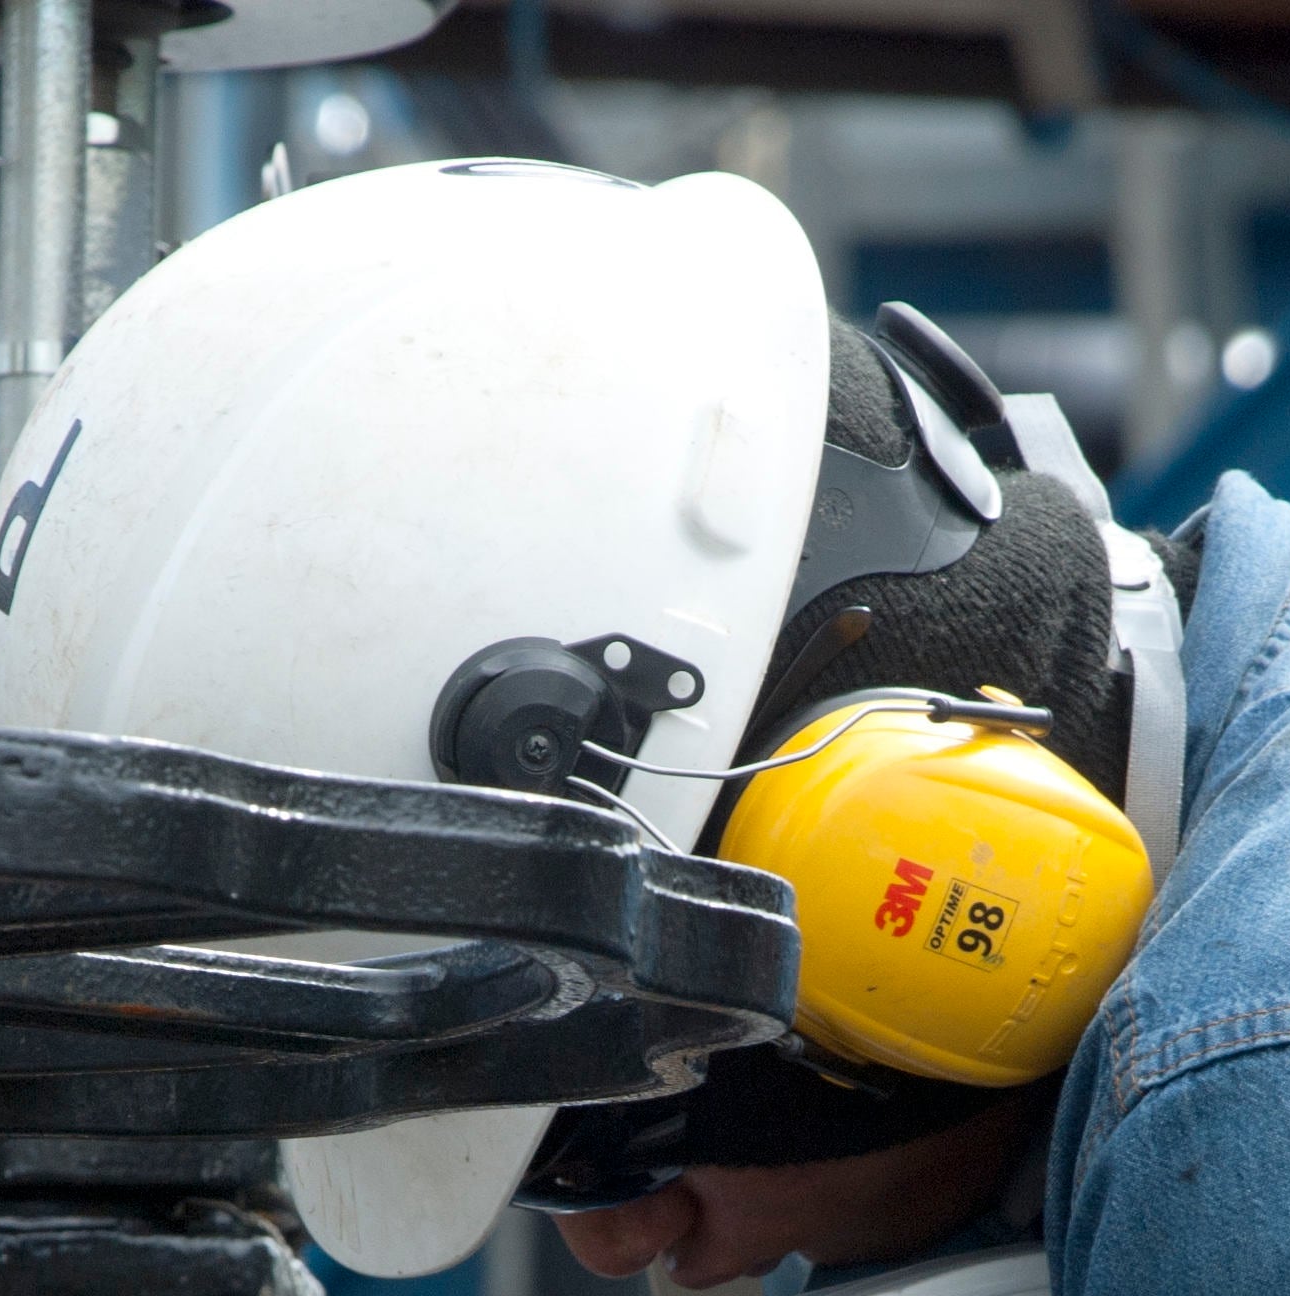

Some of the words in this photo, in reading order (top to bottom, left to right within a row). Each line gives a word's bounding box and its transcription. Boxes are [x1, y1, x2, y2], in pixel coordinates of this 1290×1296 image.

[874, 857, 935, 938] 3M
[929, 882, 964, 950] OPTIME
[957, 901, 1005, 958] 98
